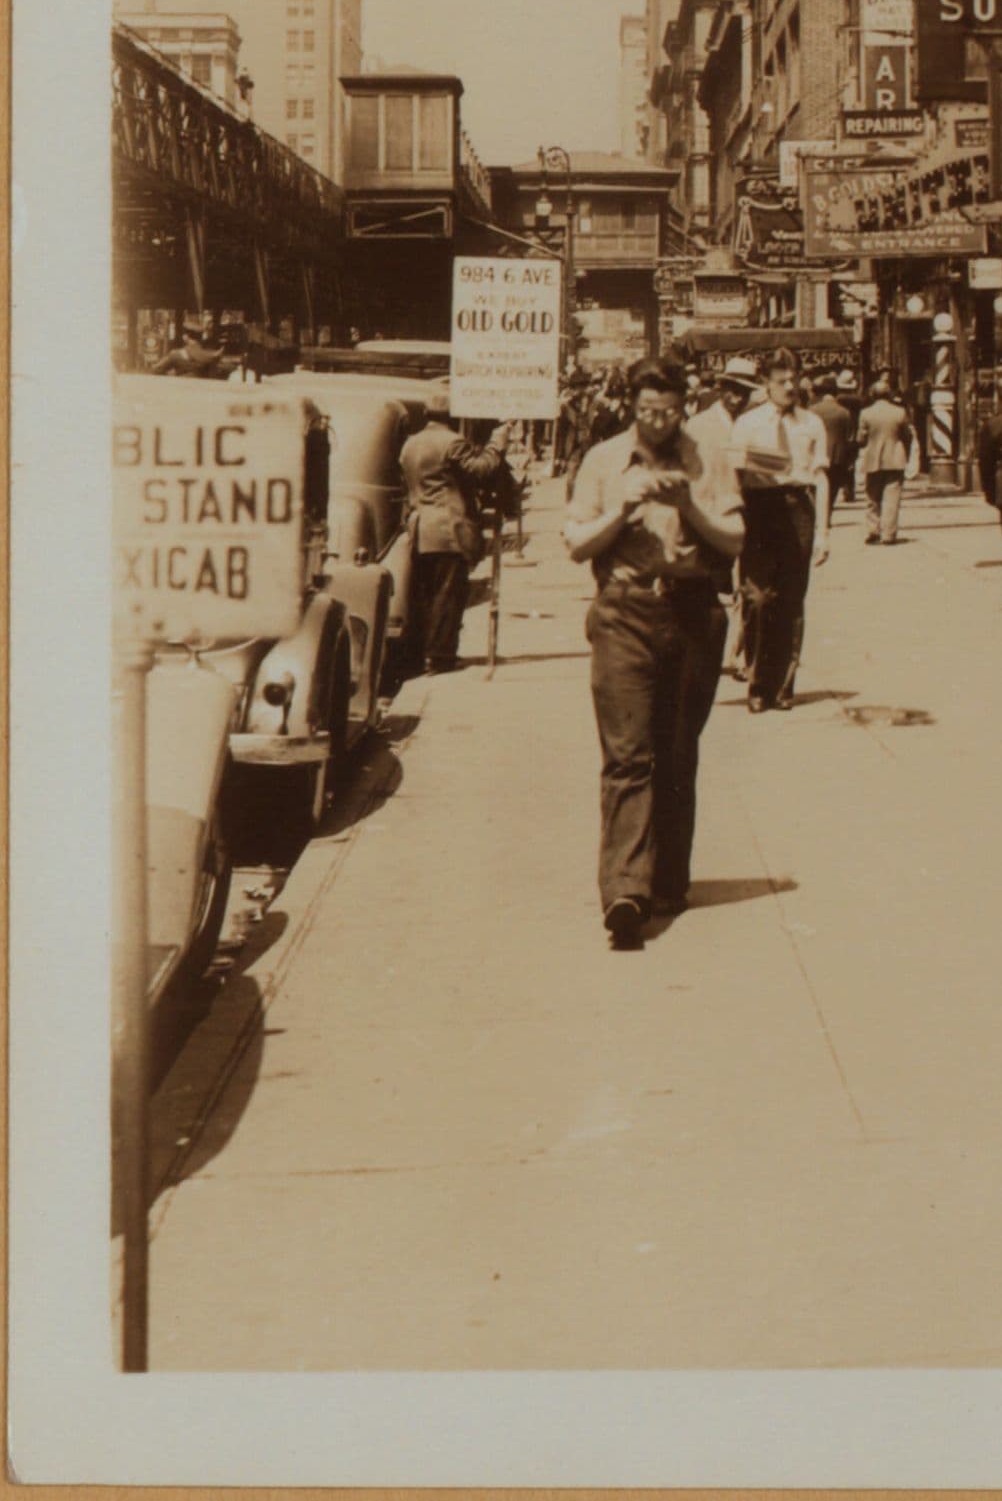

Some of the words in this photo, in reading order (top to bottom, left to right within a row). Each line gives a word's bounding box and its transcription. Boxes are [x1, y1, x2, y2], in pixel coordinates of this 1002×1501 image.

[845, 116, 923, 135] REPAIRING
[861, 237, 961, 251] ENTRANCE
[460, 266, 494, 284] 984
[504, 268, 515, 285] 6
[522, 268, 554, 287] AVE
[456, 310, 494, 333] OLD
[500, 311, 554, 336] GOLD
[142, 478, 293, 526] STAND
[121, 546, 249, 604] XICAB
